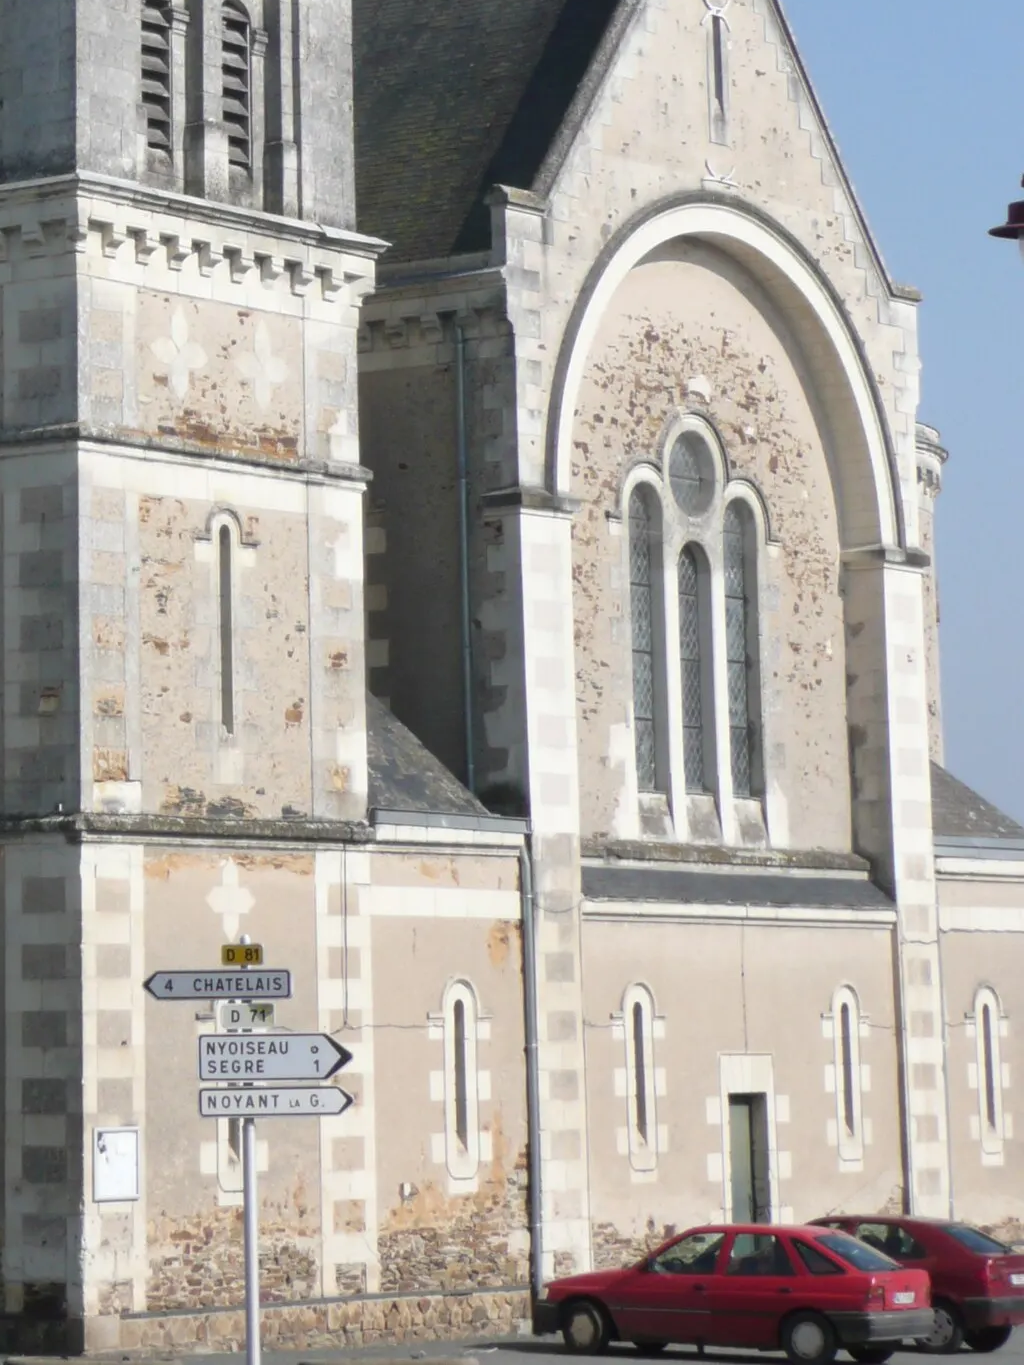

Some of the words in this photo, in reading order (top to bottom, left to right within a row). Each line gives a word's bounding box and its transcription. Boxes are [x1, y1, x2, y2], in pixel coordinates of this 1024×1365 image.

[227, 949, 235, 961] D
[244, 948, 259, 961] 81
[164, 979, 173, 992] 4
[193, 977, 282, 992] CHATELAIS
[231, 1010, 240, 1023] D
[250, 1009, 266, 1022] 71
[206, 1041, 289, 1055] NYOISEAU
[208, 1060, 264, 1074] SEGRE
[313, 1059, 319, 1073] 1
[207, 1095, 279, 1109] NOYANT
[290, 1099, 300, 1108] LA
[310, 1094, 325, 1108] G.
